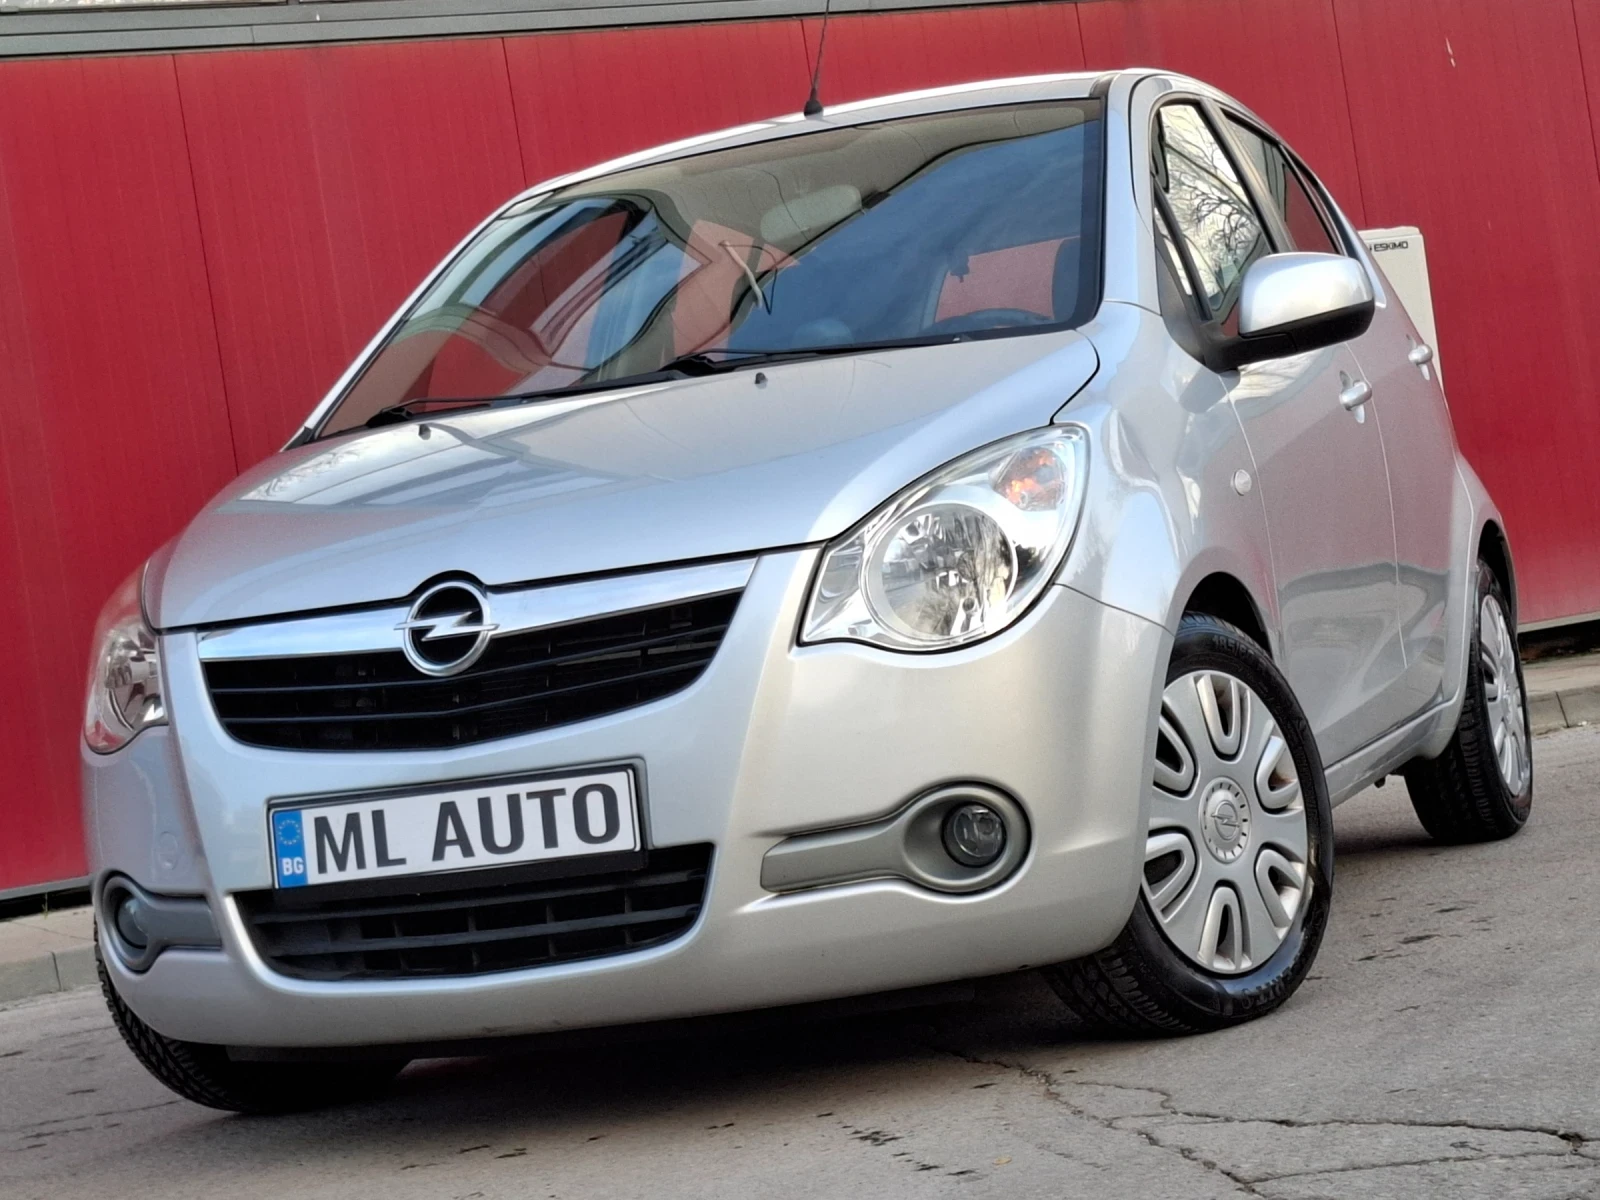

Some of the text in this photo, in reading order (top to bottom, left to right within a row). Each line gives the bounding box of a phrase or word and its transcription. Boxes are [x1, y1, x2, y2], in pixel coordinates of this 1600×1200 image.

[1373, 241, 1409, 252] ESKIMO
[313, 783, 621, 875] ML AUTO
[282, 856, 304, 877] BG
